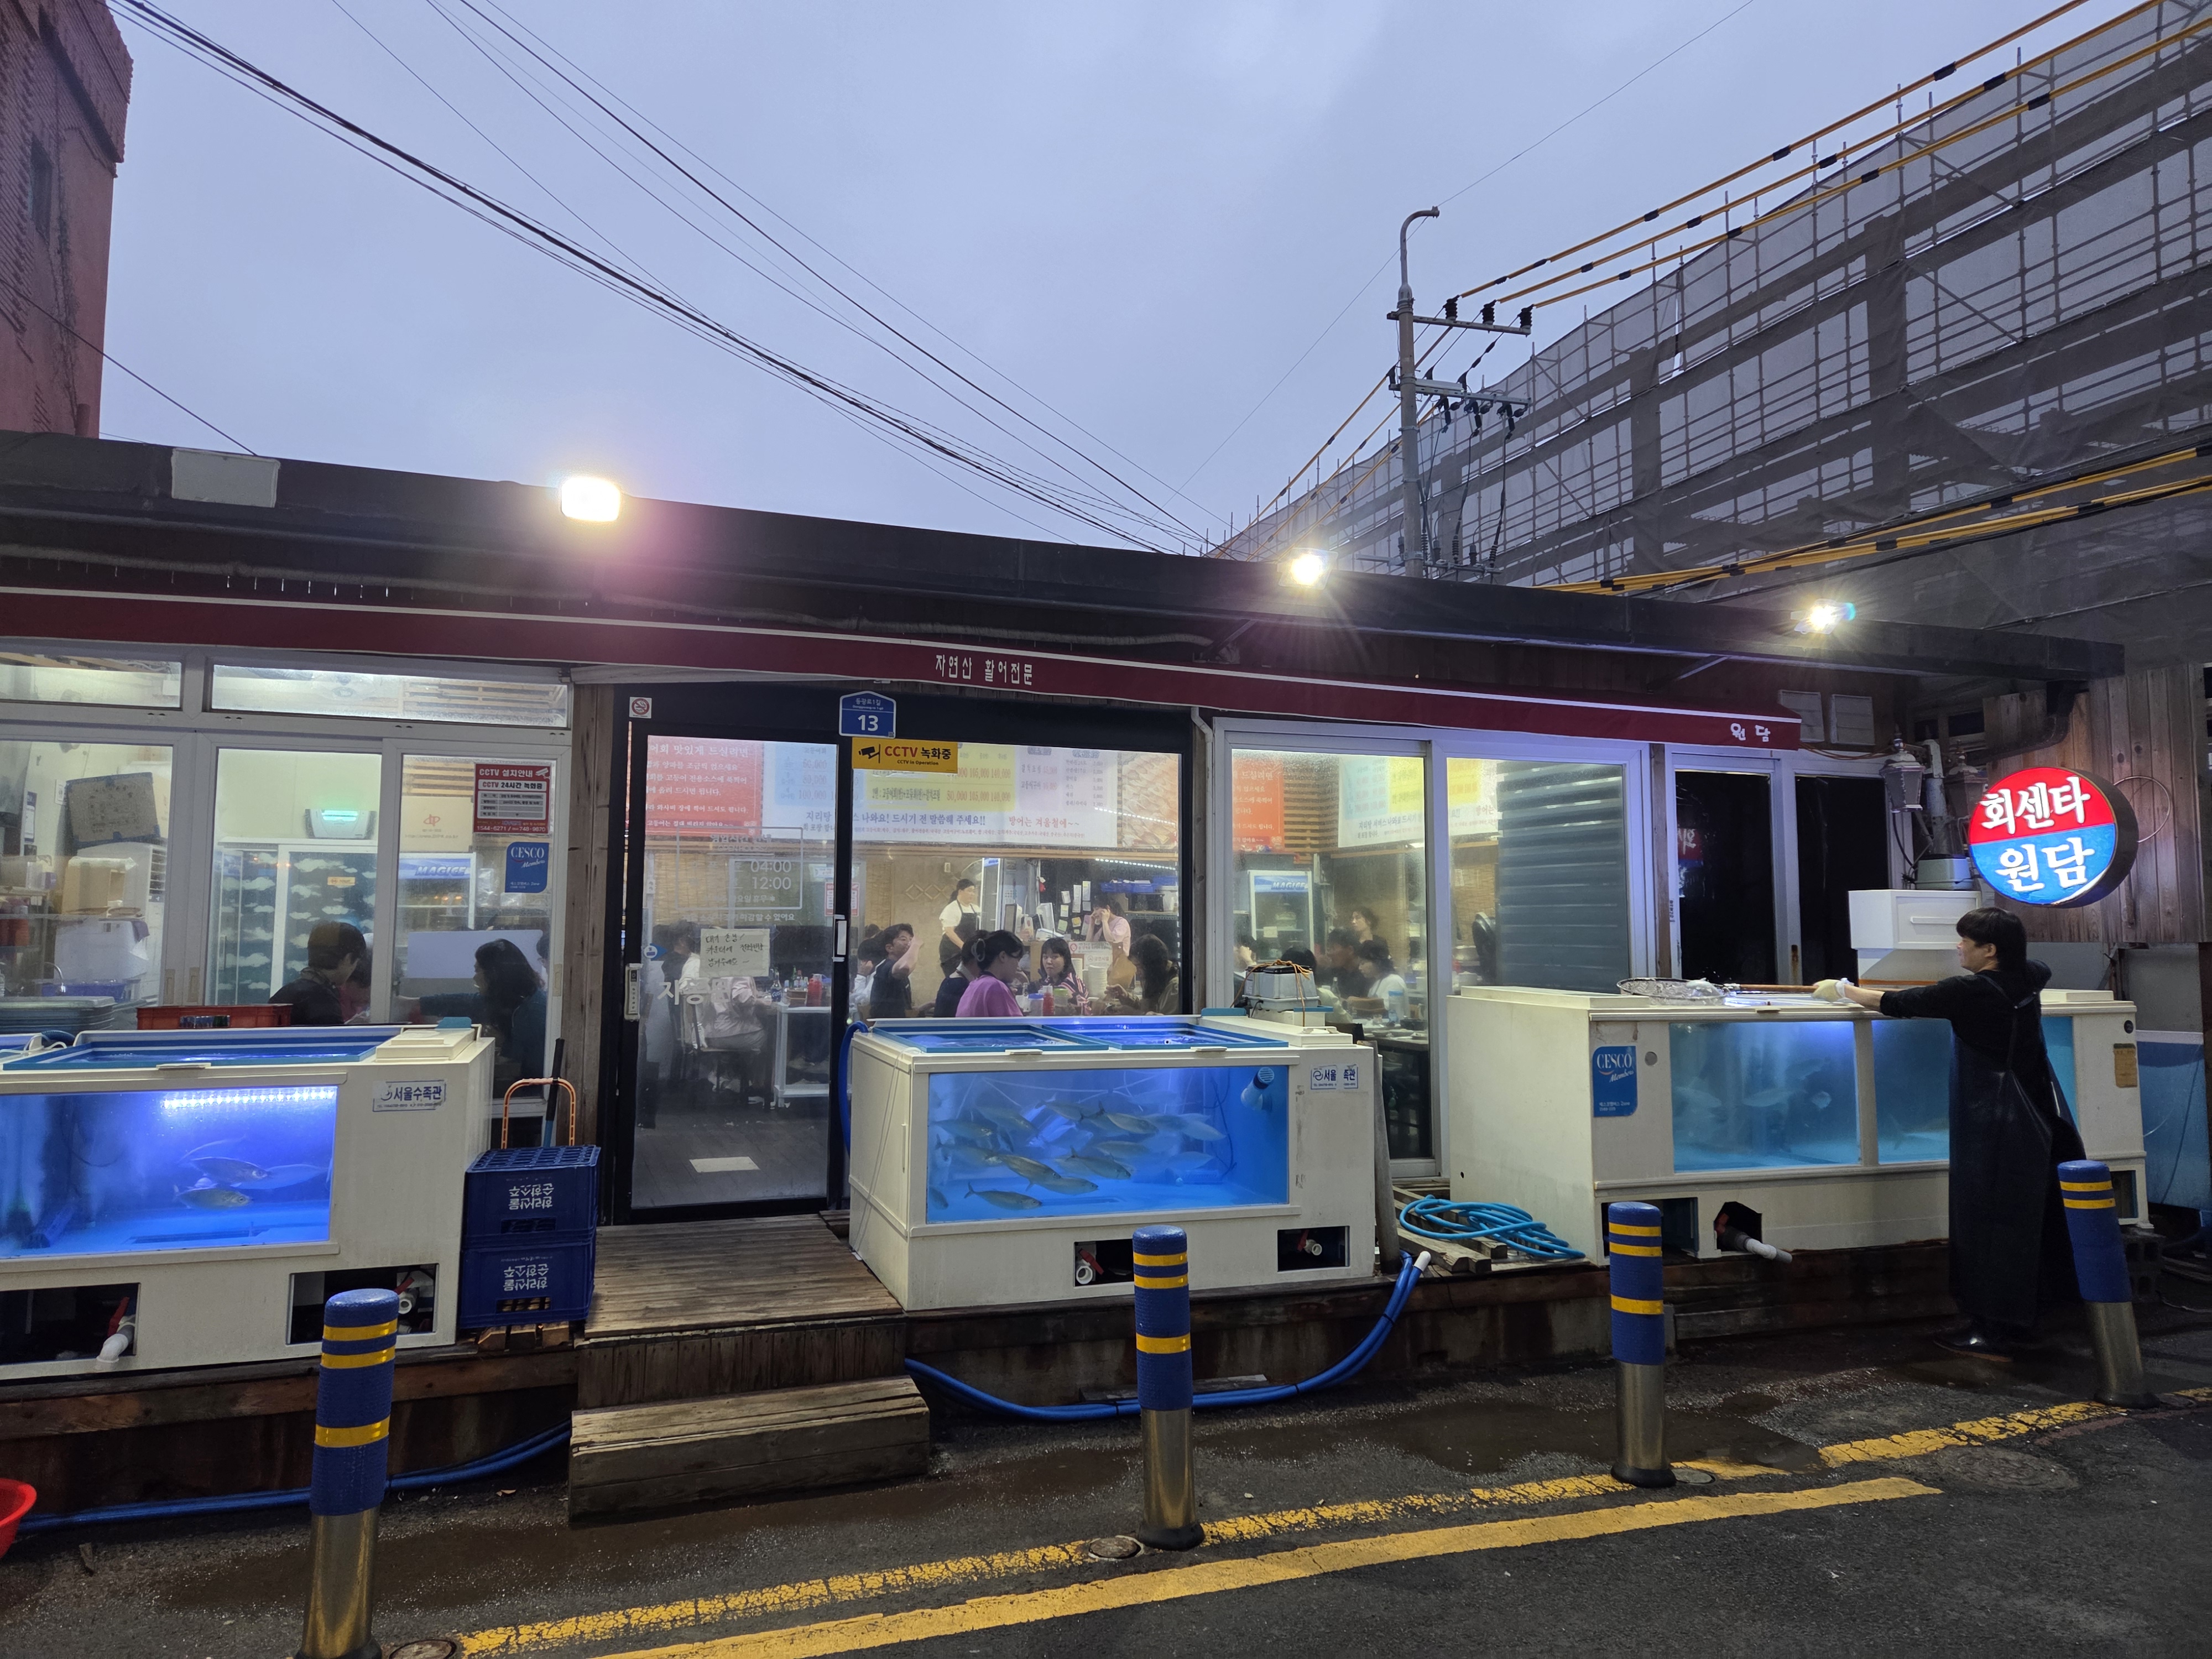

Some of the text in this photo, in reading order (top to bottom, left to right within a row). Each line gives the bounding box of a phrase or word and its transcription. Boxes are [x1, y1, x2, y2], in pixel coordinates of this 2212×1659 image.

[936, 654, 1032, 686] 자연산 활어전문
[858, 714, 878, 732] 13
[674, 745, 704, 756] 맛있게
[885, 746, 918, 758] CCTV
[921, 747, 951, 760] 녹화중
[1979, 775, 2091, 835] 회센타
[862, 812, 889, 824] 나와요!
[891, 813, 917, 825] 드시기
[919, 813, 927, 825] 전
[930, 814, 954, 826] 말씀해
[956, 815, 986, 826] 주세요!!
[510, 847, 545, 858] CESCO
[750, 860, 792, 873] 04:00
[1995, 837, 2096, 892] 원담
[752, 876, 792, 890] 12:00
[705, 934, 719, 943] 대기
[706, 945, 733, 955] 카운터에
[1597, 1053, 1632, 1069] CESCO
[1609, 1068, 1634, 1083] Members
[394, 1086, 442, 1102] 서울수족관
[509, 1183, 555, 1197] 순한소주
[508, 1196, 553, 1210] 한라산물
[504, 1263, 549, 1278] 순한소주
[503, 1277, 548, 1291] 한라산물
